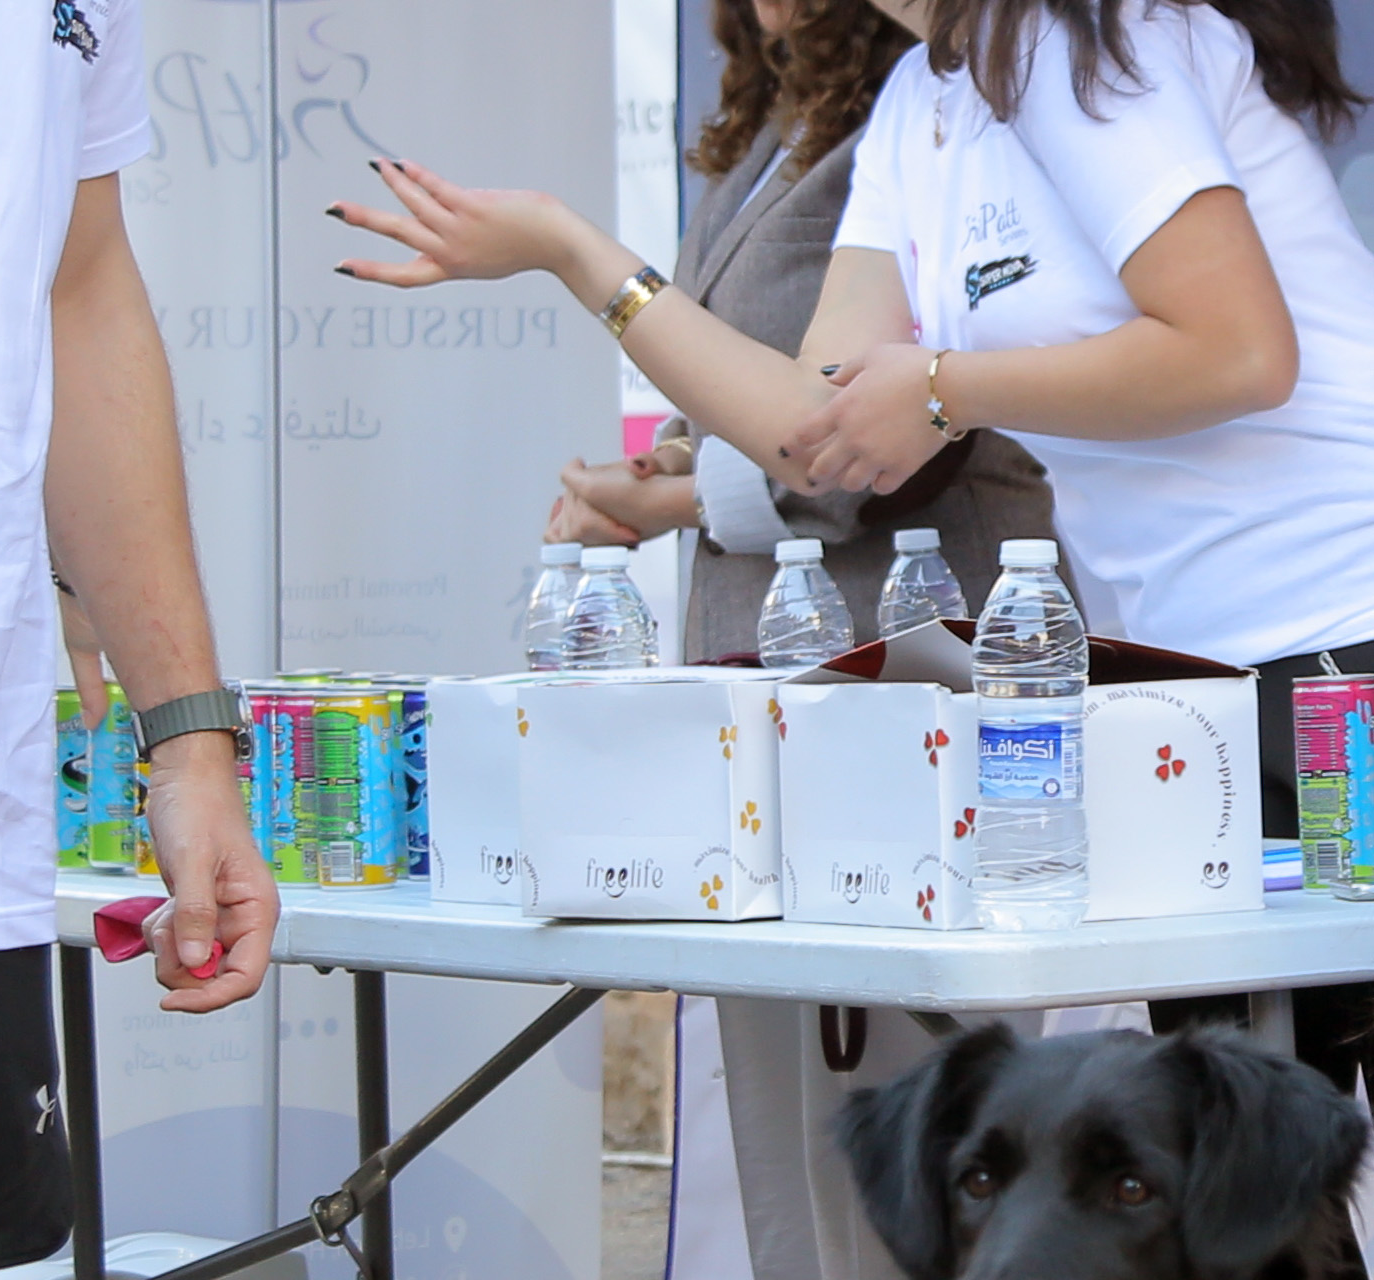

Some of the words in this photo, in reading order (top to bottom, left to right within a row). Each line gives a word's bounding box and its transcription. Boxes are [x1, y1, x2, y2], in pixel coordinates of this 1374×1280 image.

[1108, 686, 1185, 710] maximize
[1186, 706, 1219, 739] your
[586, 857, 664, 898] freelife
[830, 861, 891, 904] freelife
